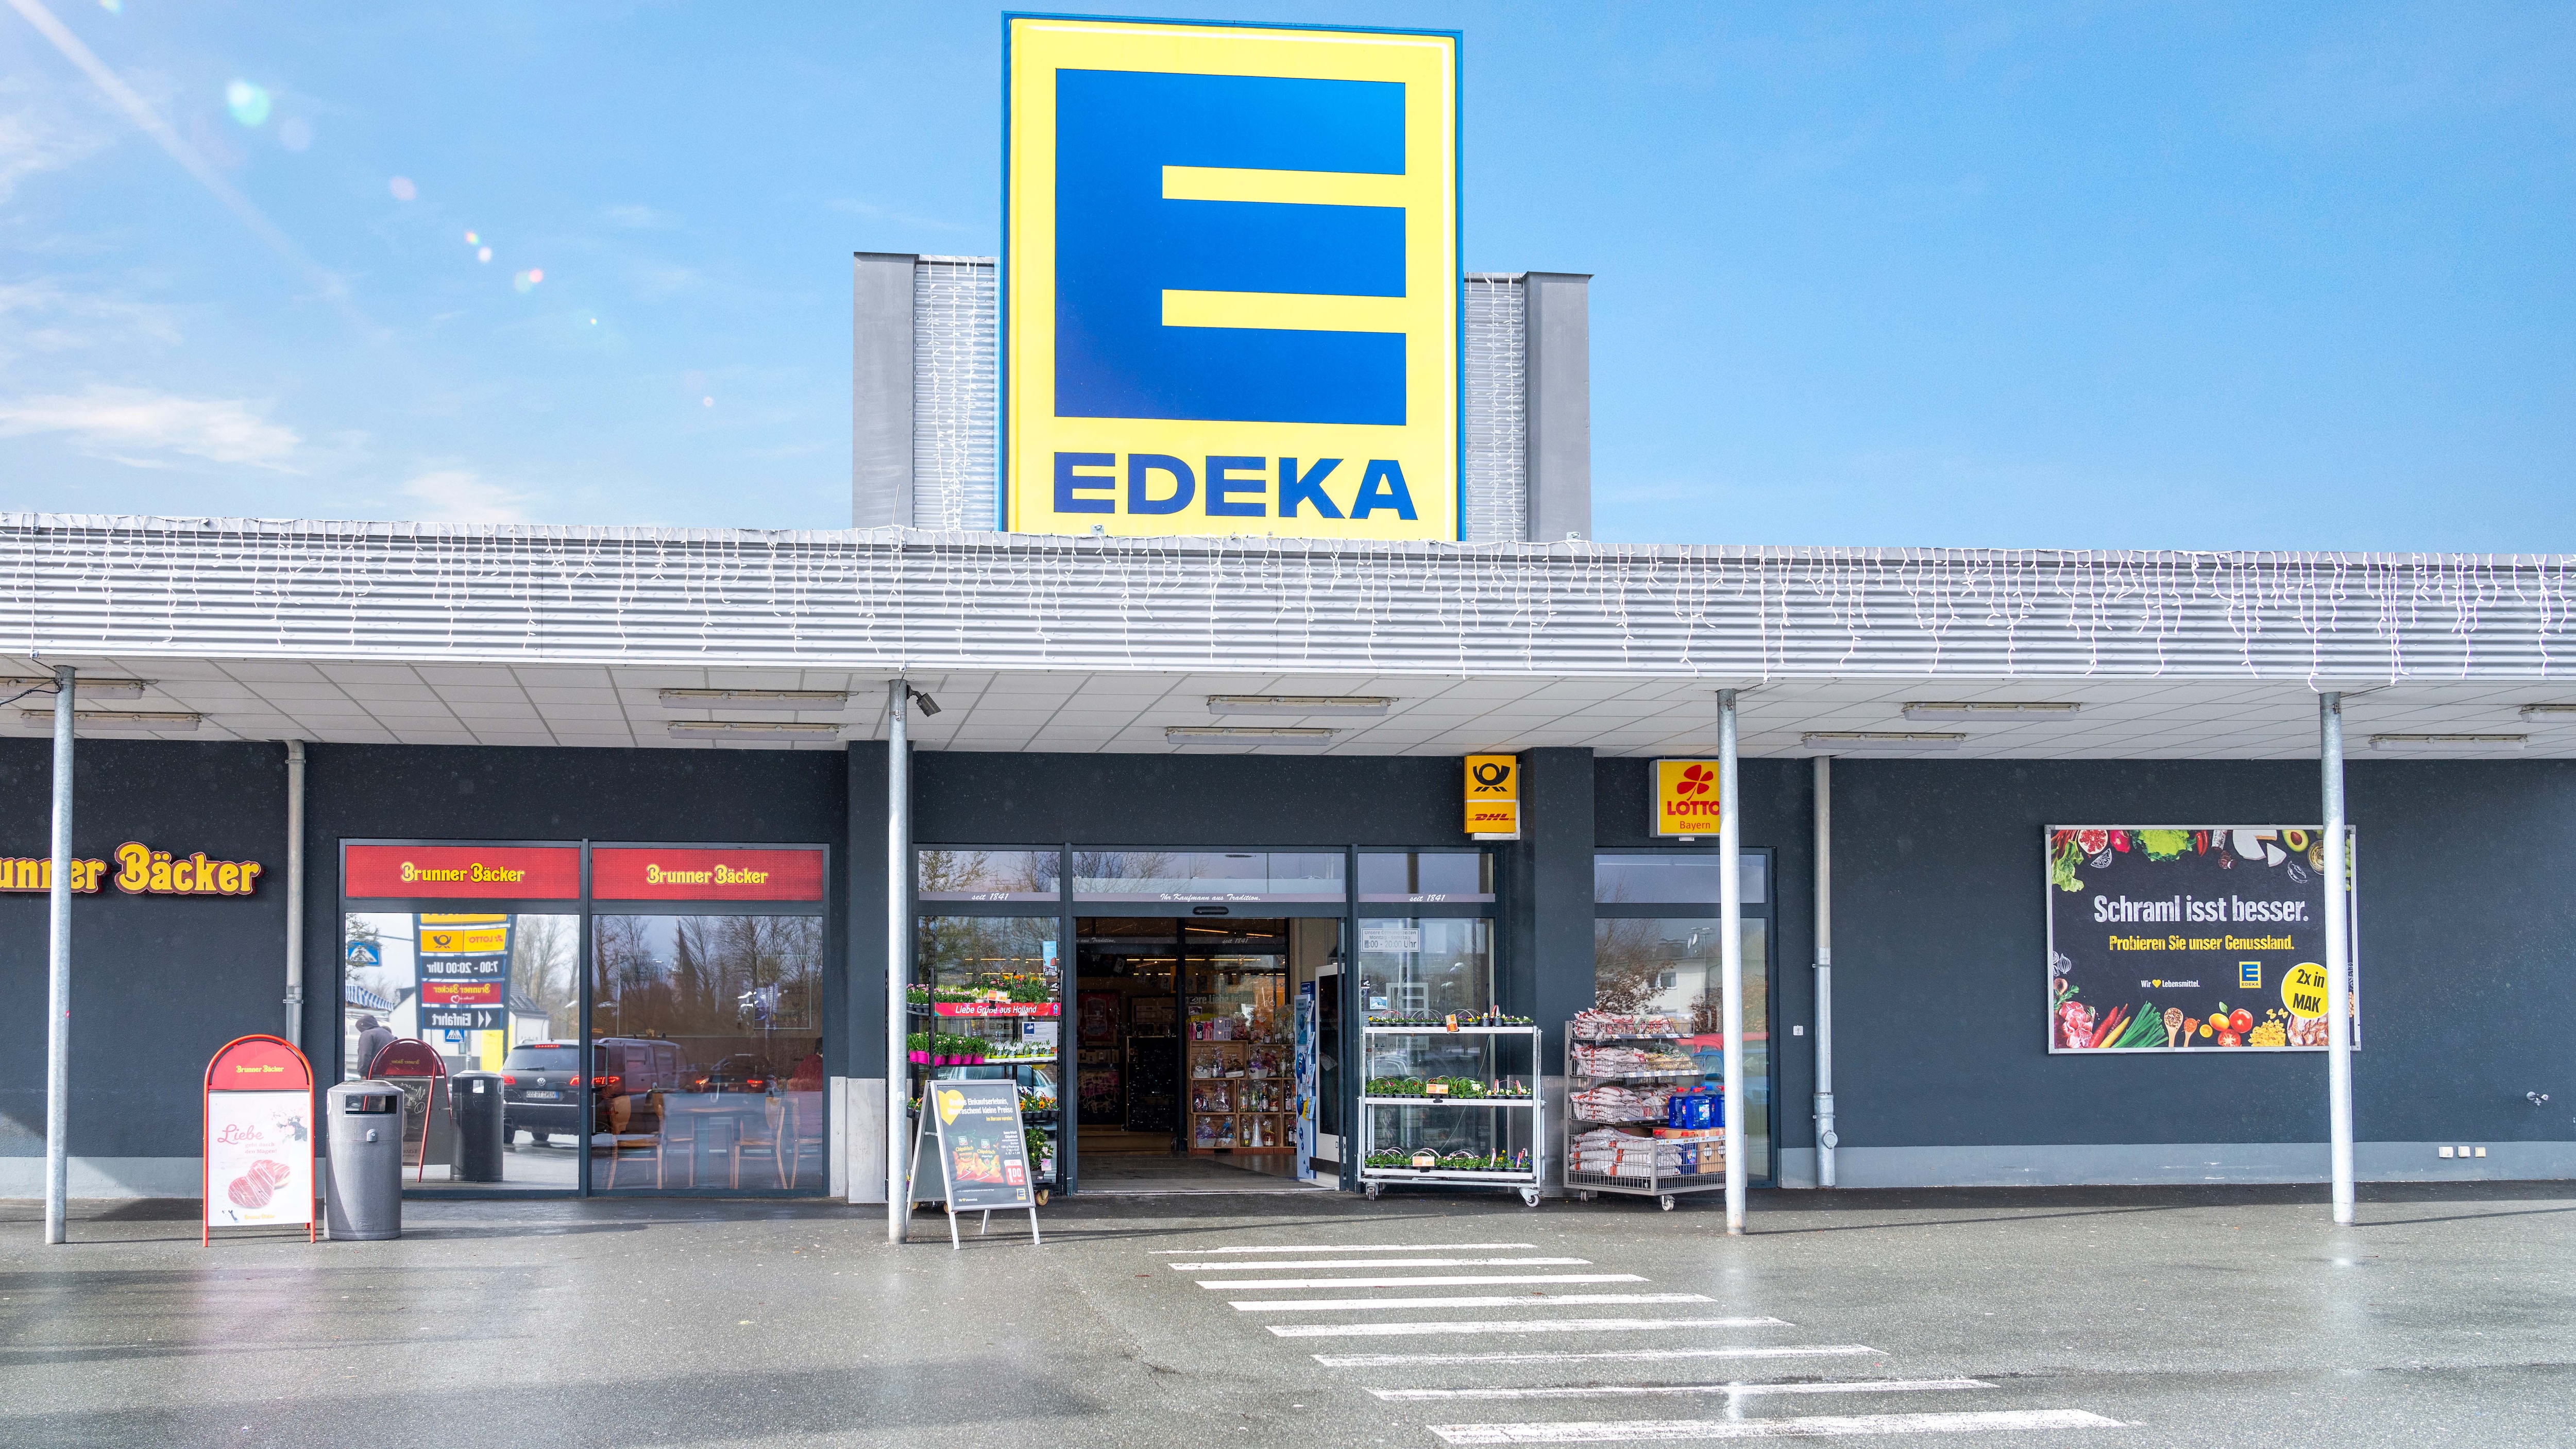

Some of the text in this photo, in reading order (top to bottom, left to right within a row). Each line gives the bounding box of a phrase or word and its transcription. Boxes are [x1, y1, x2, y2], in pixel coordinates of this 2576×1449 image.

[1054, 68, 1406, 425] E
[1054, 452, 1418, 520] EDEKA
[1667, 801, 1720, 815] LOTTO
[1680, 821, 1710, 830] Bayern
[0, 844, 260, 892] uner Bäcker
[401, 862, 525, 882] Brunner Bäcker
[647, 864, 768, 884] Brunner Bäcker
[1173, 893, 1210, 902] Kaufmann
[2094, 895, 2309, 922] Schraml isst besser.
[1365, 940, 1378, 948] :00
[2109, 935, 2295, 950] Probieren Sie unser Genussland.
[2141, 980, 2151, 988] Wir
[2296, 968, 2325, 988] 2x in
[955, 1005, 974, 1014] Liebe
[2293, 993, 2321, 1013] MAK
[236, 1065, 262, 1073] Brunner
[968, 1097, 1009, 1105] Einkaufserlebnis,
[217, 1124, 264, 1145] Liebe
